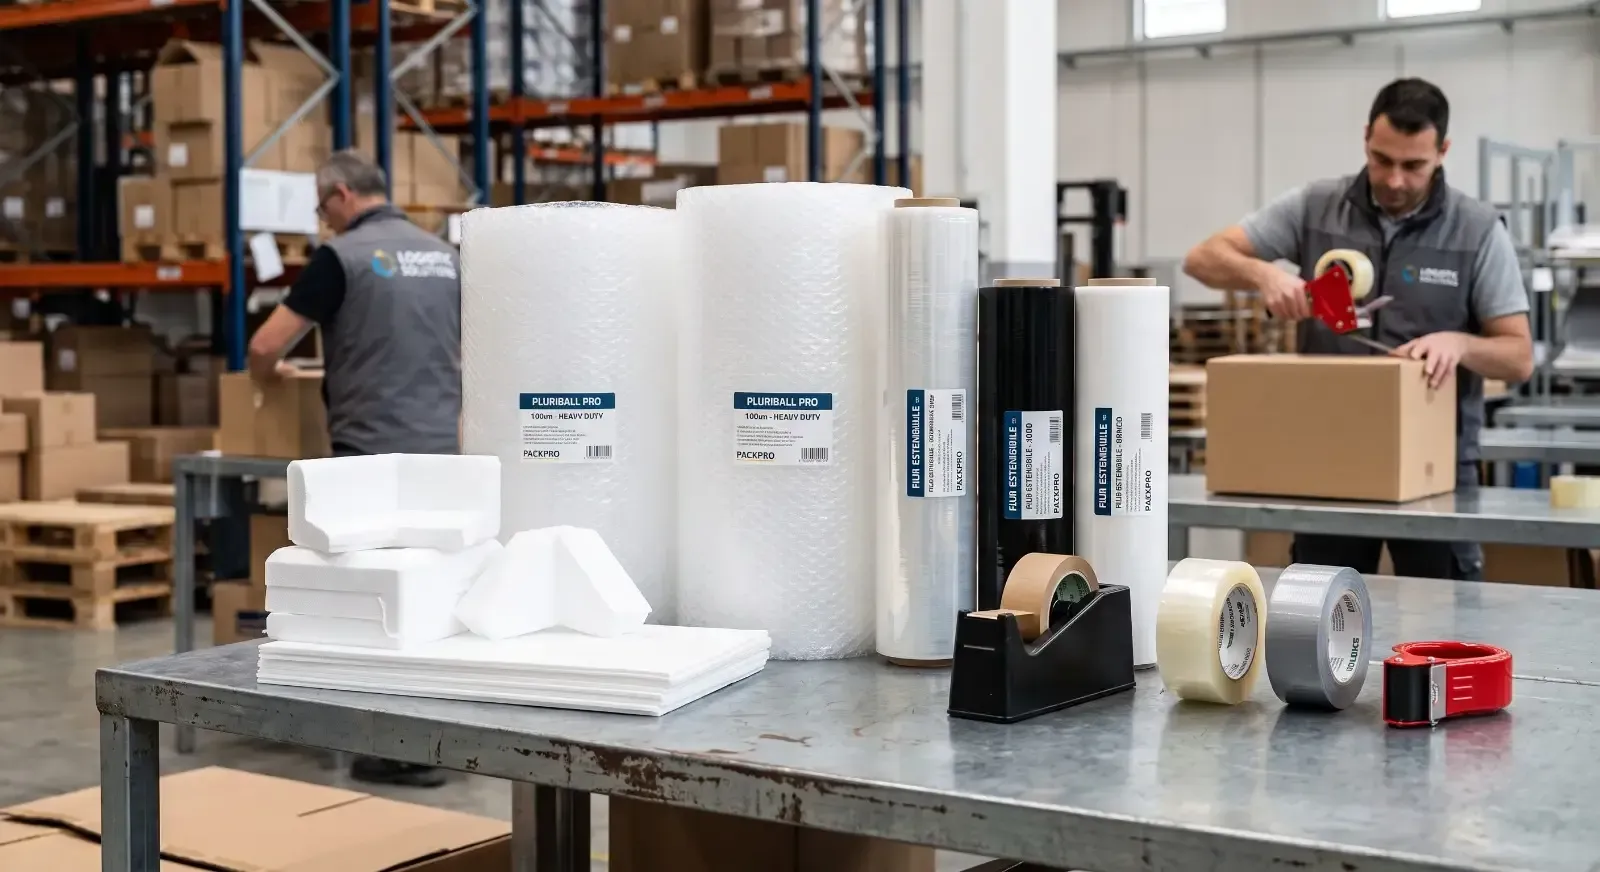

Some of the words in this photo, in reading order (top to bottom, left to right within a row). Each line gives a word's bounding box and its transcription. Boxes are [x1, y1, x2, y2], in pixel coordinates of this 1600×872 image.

[532, 397, 580, 406] PLURIBALL
[582, 397, 602, 406] PRO
[747, 397, 796, 406] PLURIBALL
[798, 398, 818, 407] PRO
[773, 413, 798, 421] HEAVY
[523, 450, 560, 458] PACKPRO
[736, 451, 775, 460] PACKPRO
